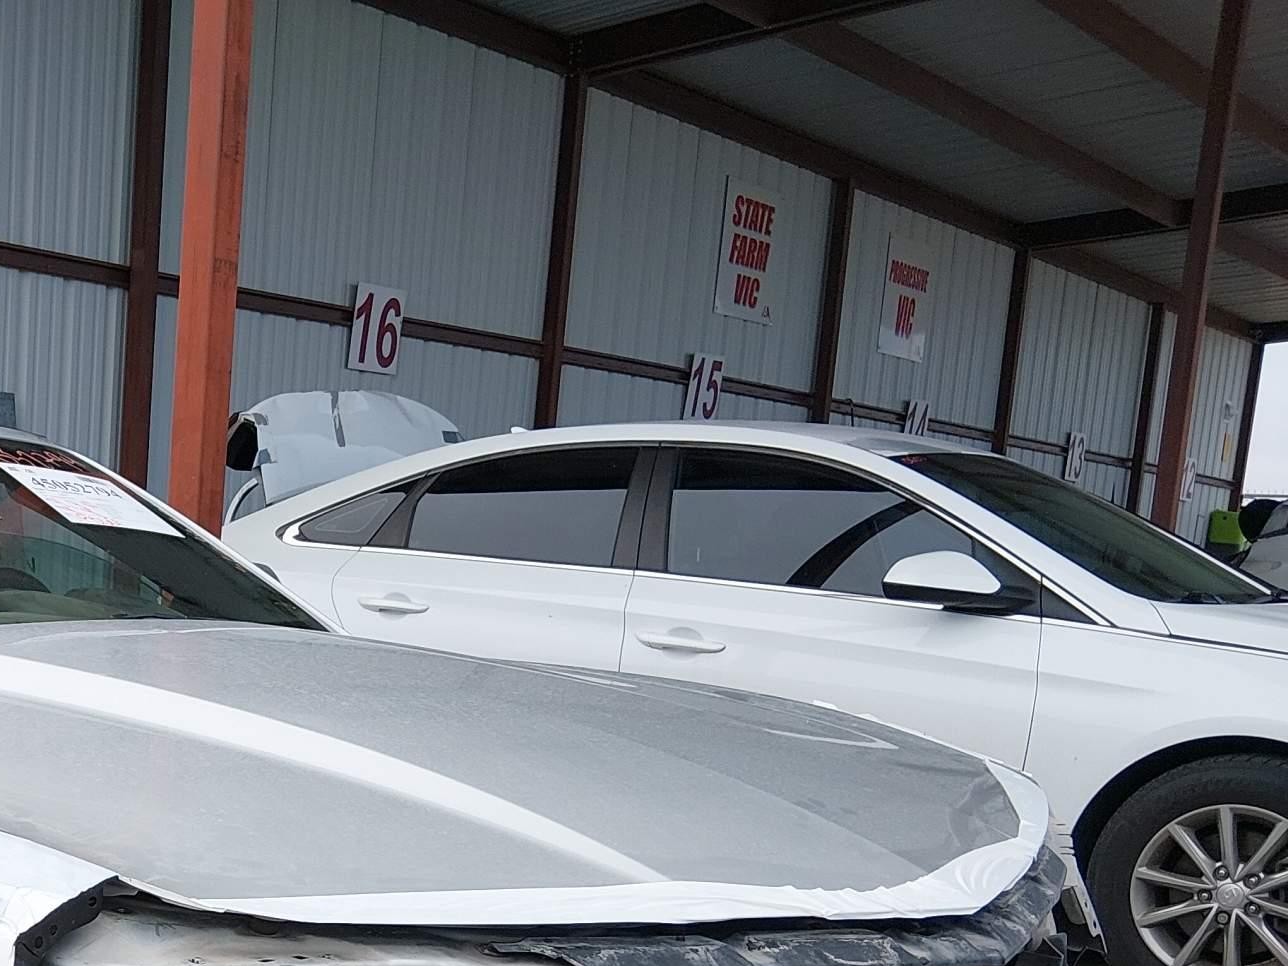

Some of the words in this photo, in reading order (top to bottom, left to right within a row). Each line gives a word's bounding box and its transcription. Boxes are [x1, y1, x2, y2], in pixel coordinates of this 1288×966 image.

[731, 194, 776, 237] STATE
[728, 232, 771, 273] FARM
[733, 273, 761, 309] VIC
[889, 259, 929, 293] PROGRESSIVE
[355, 292, 402, 369] 16
[895, 294, 916, 340] VIC
[691, 357, 724, 420] 15
[907, 402, 929, 437] 14
[1067, 433, 1085, 479] 13
[31, 476, 123, 499] 45052794
[1181, 461, 1196, 499] 12
